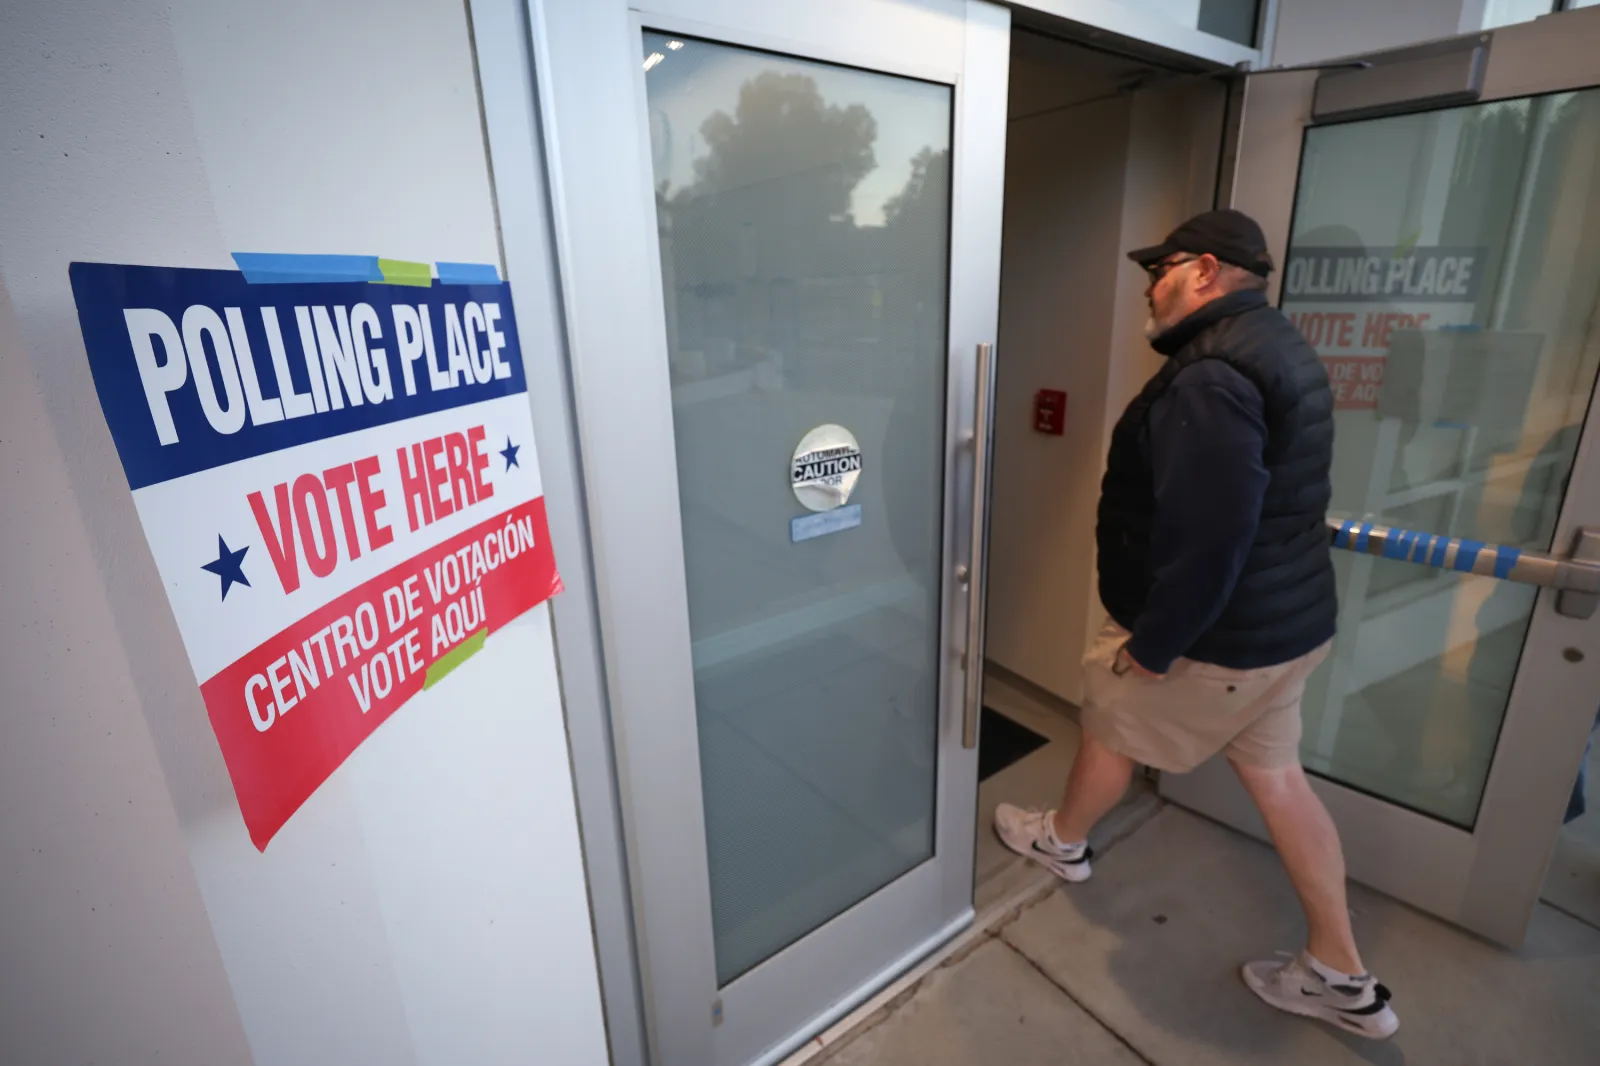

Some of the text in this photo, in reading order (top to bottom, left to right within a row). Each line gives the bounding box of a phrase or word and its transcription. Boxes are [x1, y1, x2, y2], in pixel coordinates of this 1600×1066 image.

[1286, 256, 1475, 295] OLLING PLACE
[122, 301, 512, 447] POLLING PLACE
[1333, 362, 1357, 381] DE
[246, 424, 494, 596] VOTE HERE
[793, 455, 861, 482] CAUTION
[243, 514, 536, 734] CENTRO DE VOTACIÓN
[347, 577, 487, 715] VOTE AQUÍ
